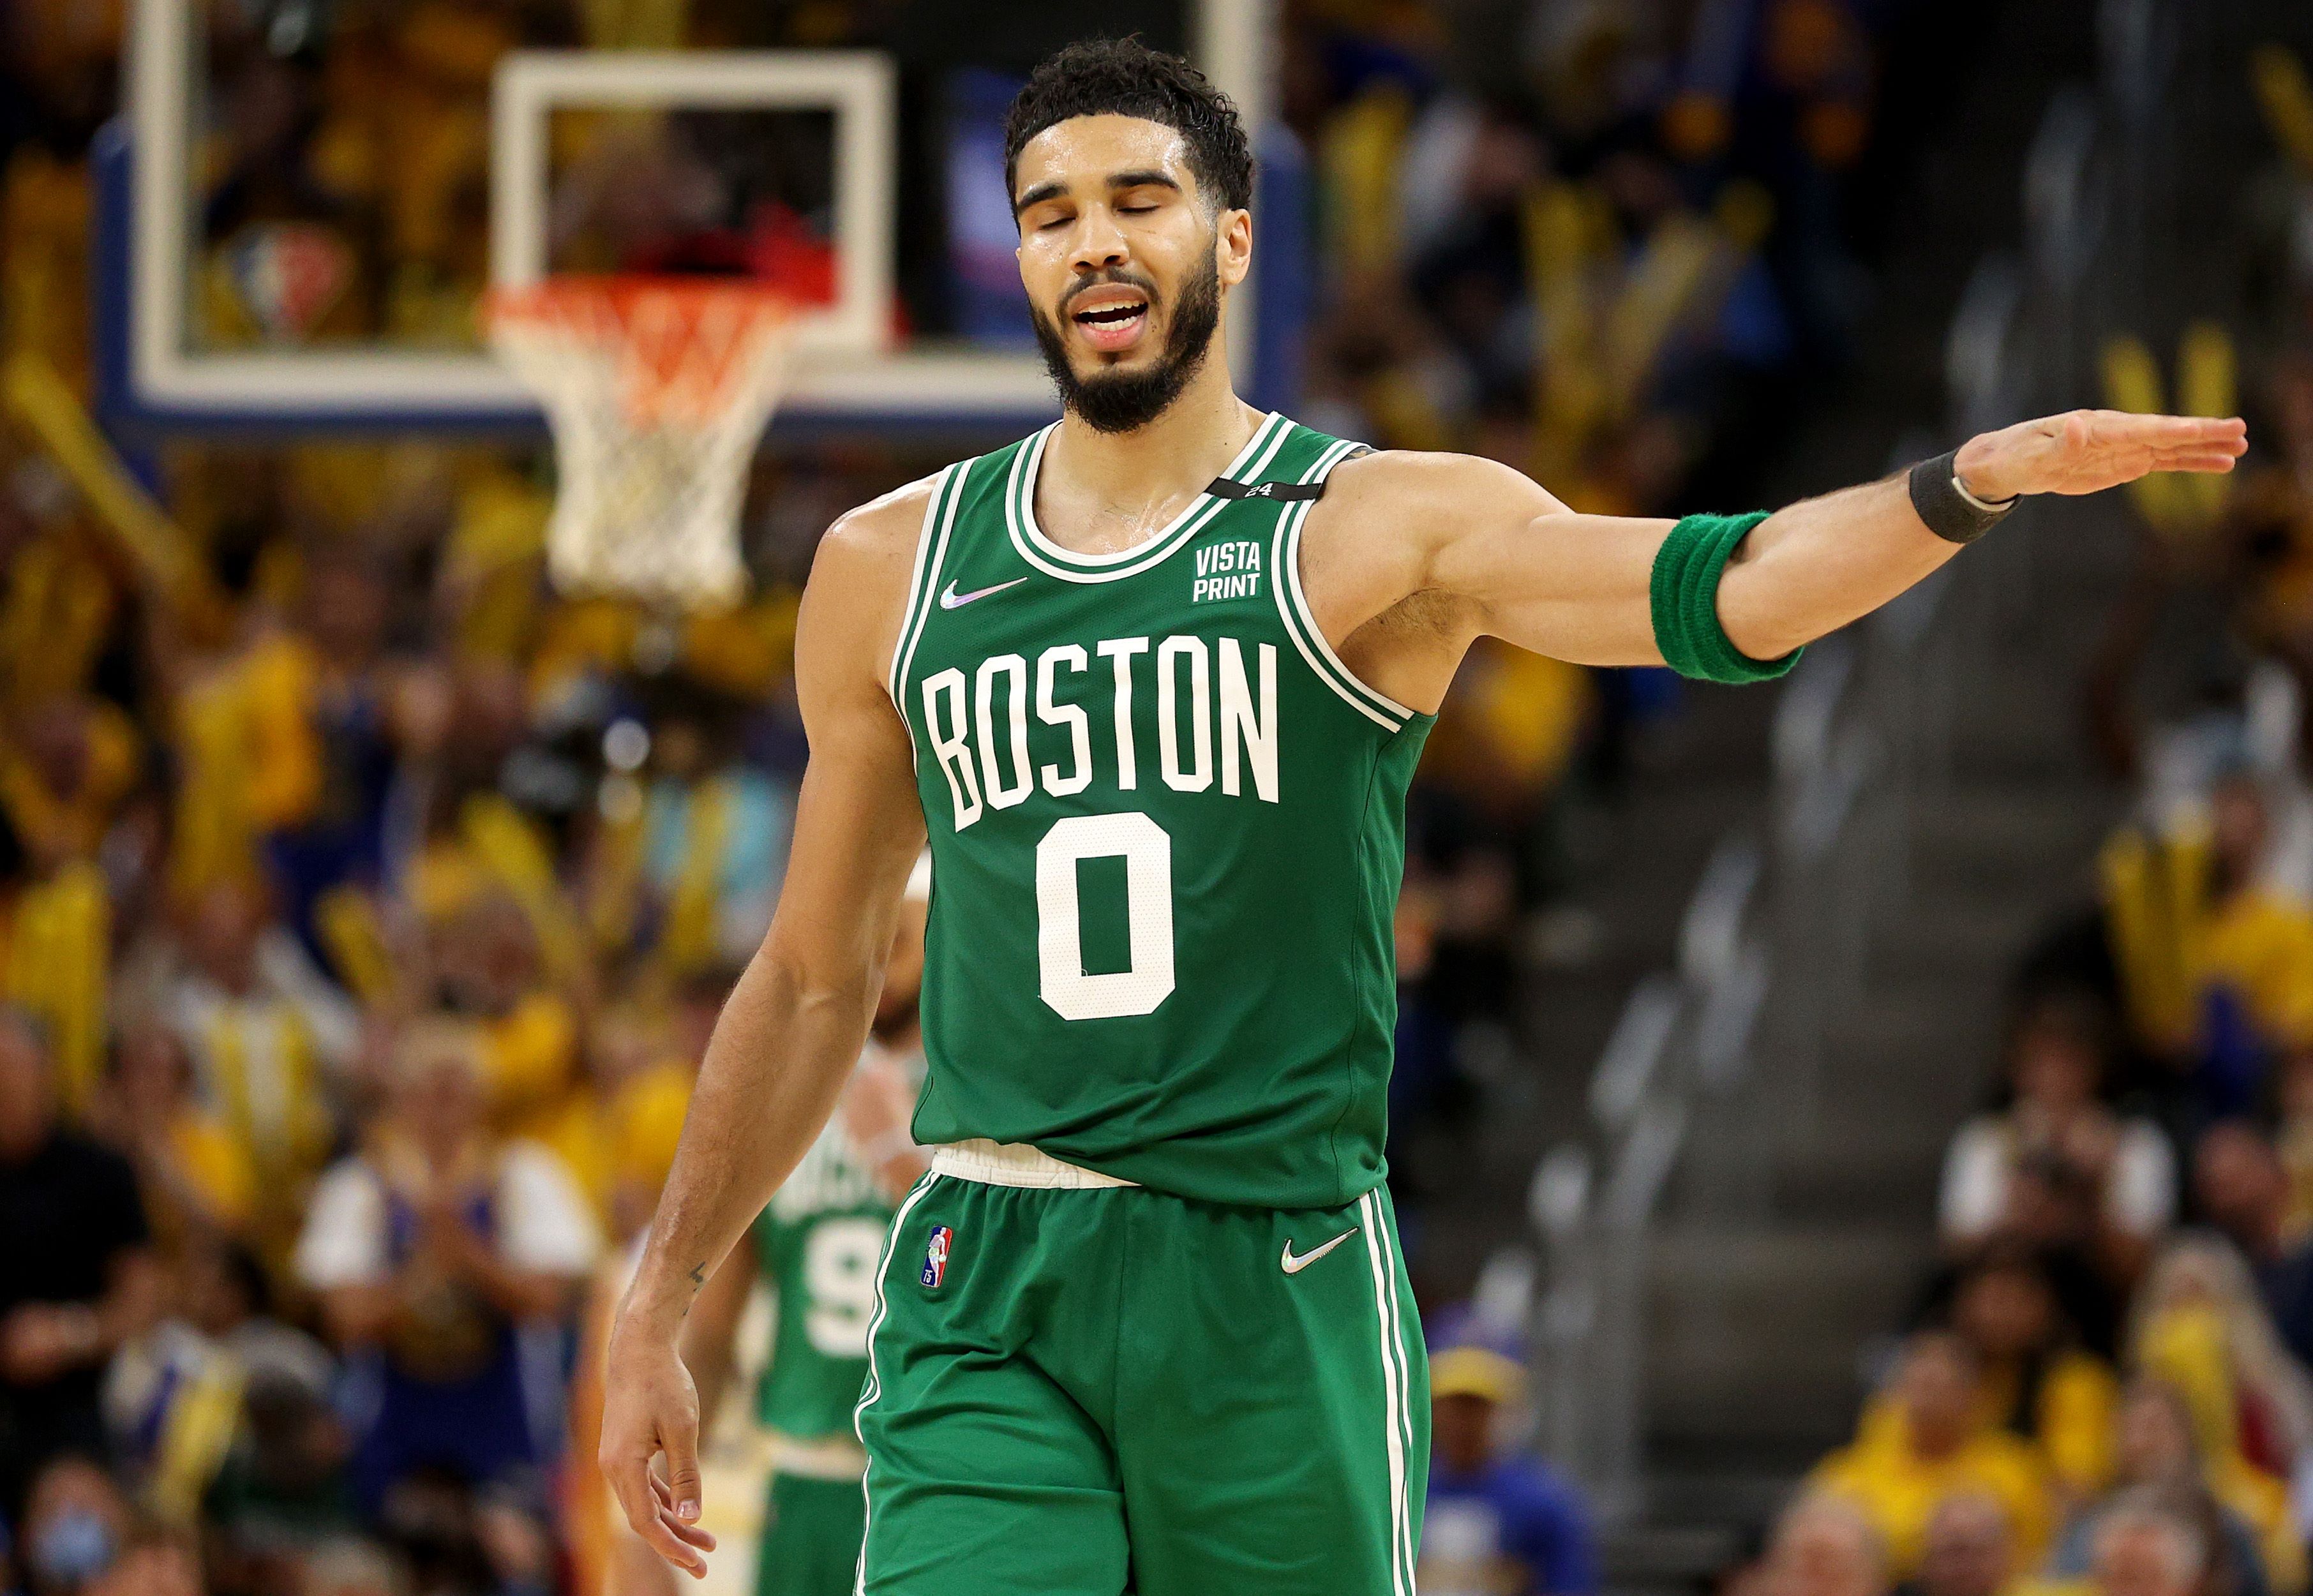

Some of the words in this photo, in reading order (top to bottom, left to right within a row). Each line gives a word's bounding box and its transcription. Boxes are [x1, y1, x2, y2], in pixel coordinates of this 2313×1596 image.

[1245, 483, 1273, 498] 24
[1196, 541, 1261, 578] VISTA
[1193, 572, 1261, 602] PRINT
[922, 635, 1279, 833] BOSTON
[1036, 811, 1176, 1021] 0
[804, 1216, 889, 1355] 9
[923, 1269, 933, 1283] 75
